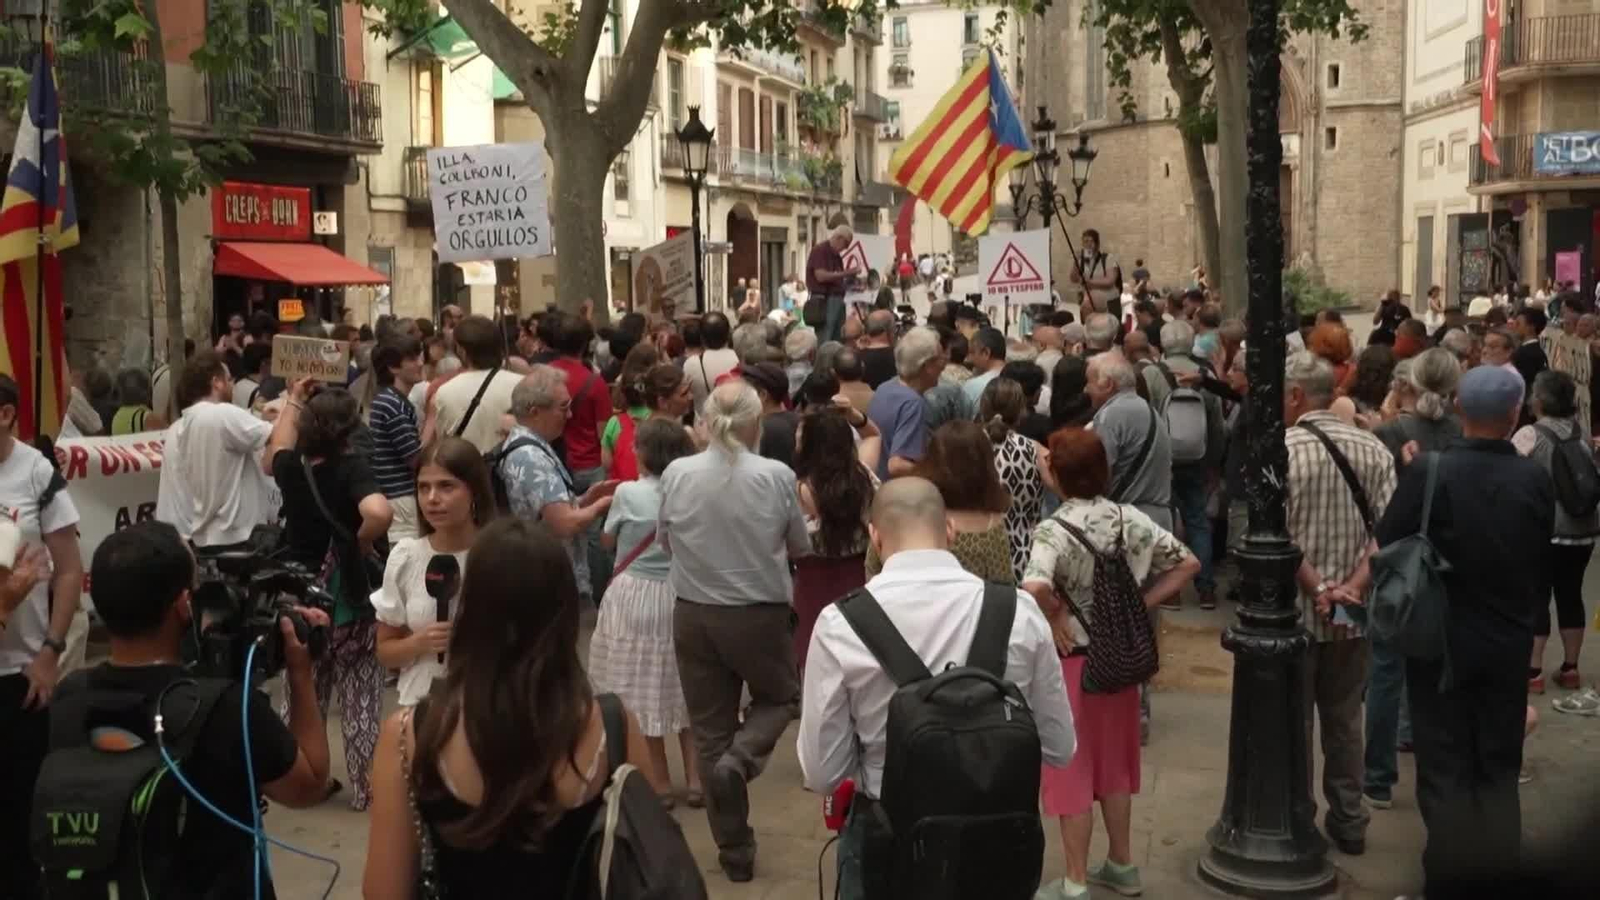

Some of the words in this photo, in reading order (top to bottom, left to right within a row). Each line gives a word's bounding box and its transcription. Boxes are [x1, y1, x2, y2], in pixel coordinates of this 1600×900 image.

[225, 195, 260, 224] CREPS
[272, 198, 299, 226] BORN
[444, 186, 527, 211] FRANCO
[457, 207, 525, 226] ESTARIA
[449, 226, 538, 250] ORGULLOS
[94, 445, 141, 476] UN
[46, 812, 99, 834] TVU
